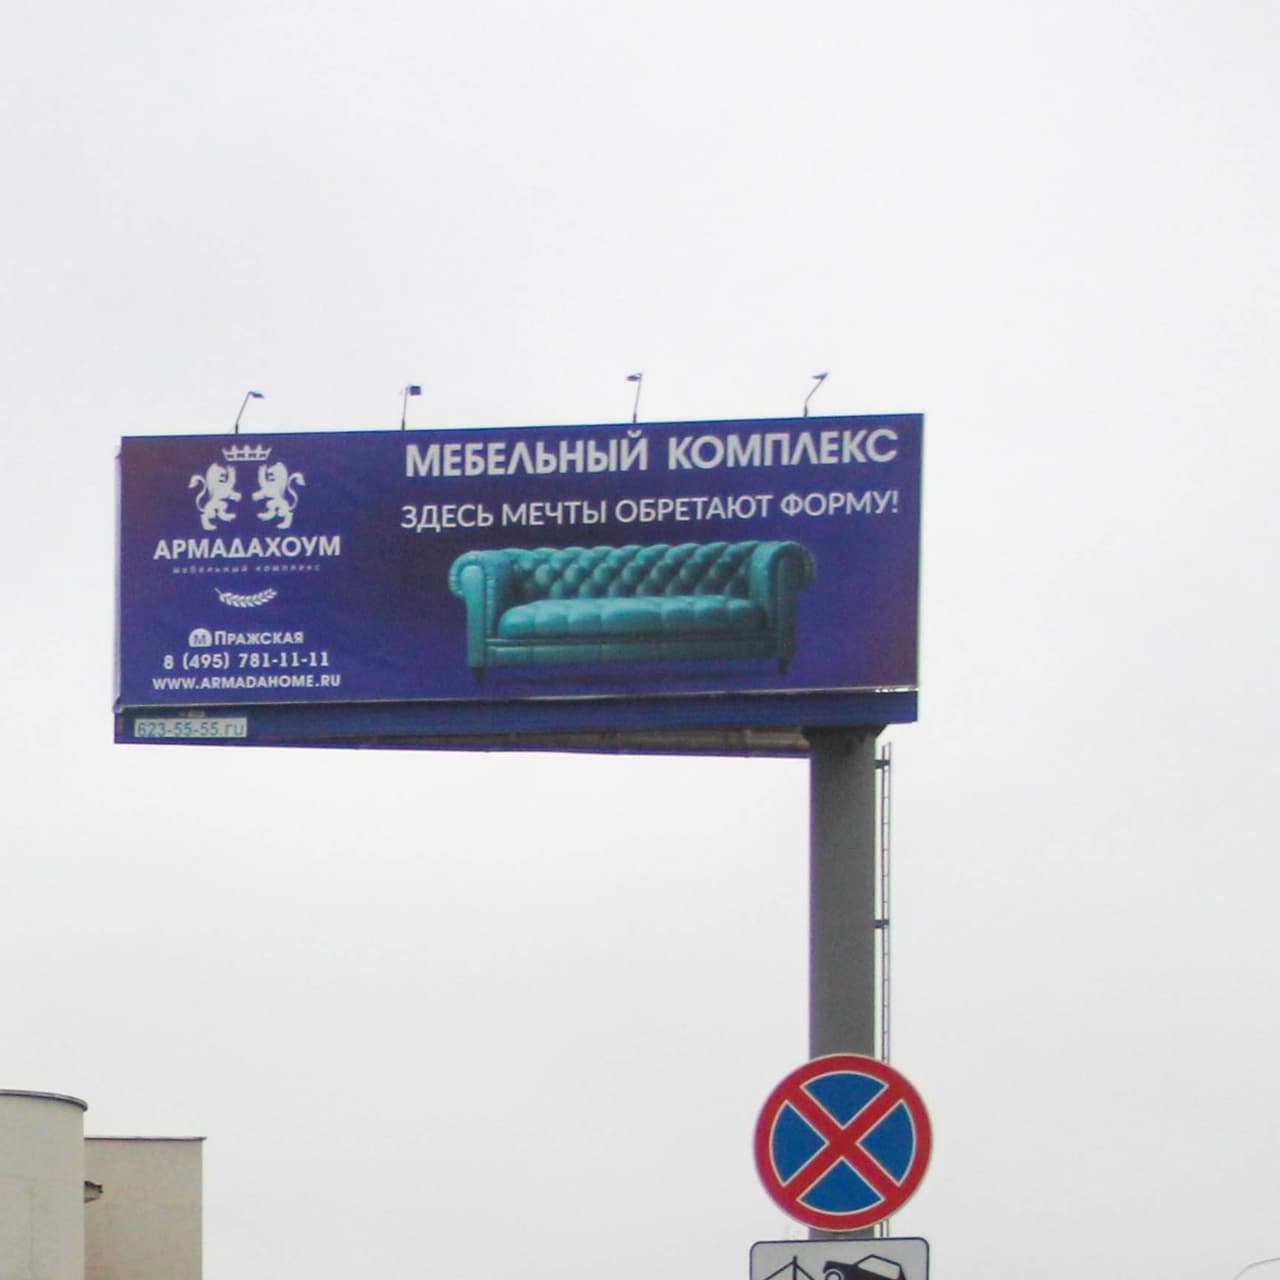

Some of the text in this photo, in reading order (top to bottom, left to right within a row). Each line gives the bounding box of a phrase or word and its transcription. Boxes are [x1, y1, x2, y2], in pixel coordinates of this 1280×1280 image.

[404, 428, 899, 477] МЕБЕЛЬНЫЙ КОМПЛЕКС
[400, 490, 900, 533] ЗДЕСЬ МЕЧТЫ ОБРЕТАЮТ ФОРМУ!
[152, 535, 341, 561] АРМАДАХОУМ
[162, 650, 330, 670] 8 (495) 781-11-11
[152, 673, 341, 690] WWW.ARMADAHOME.RU
